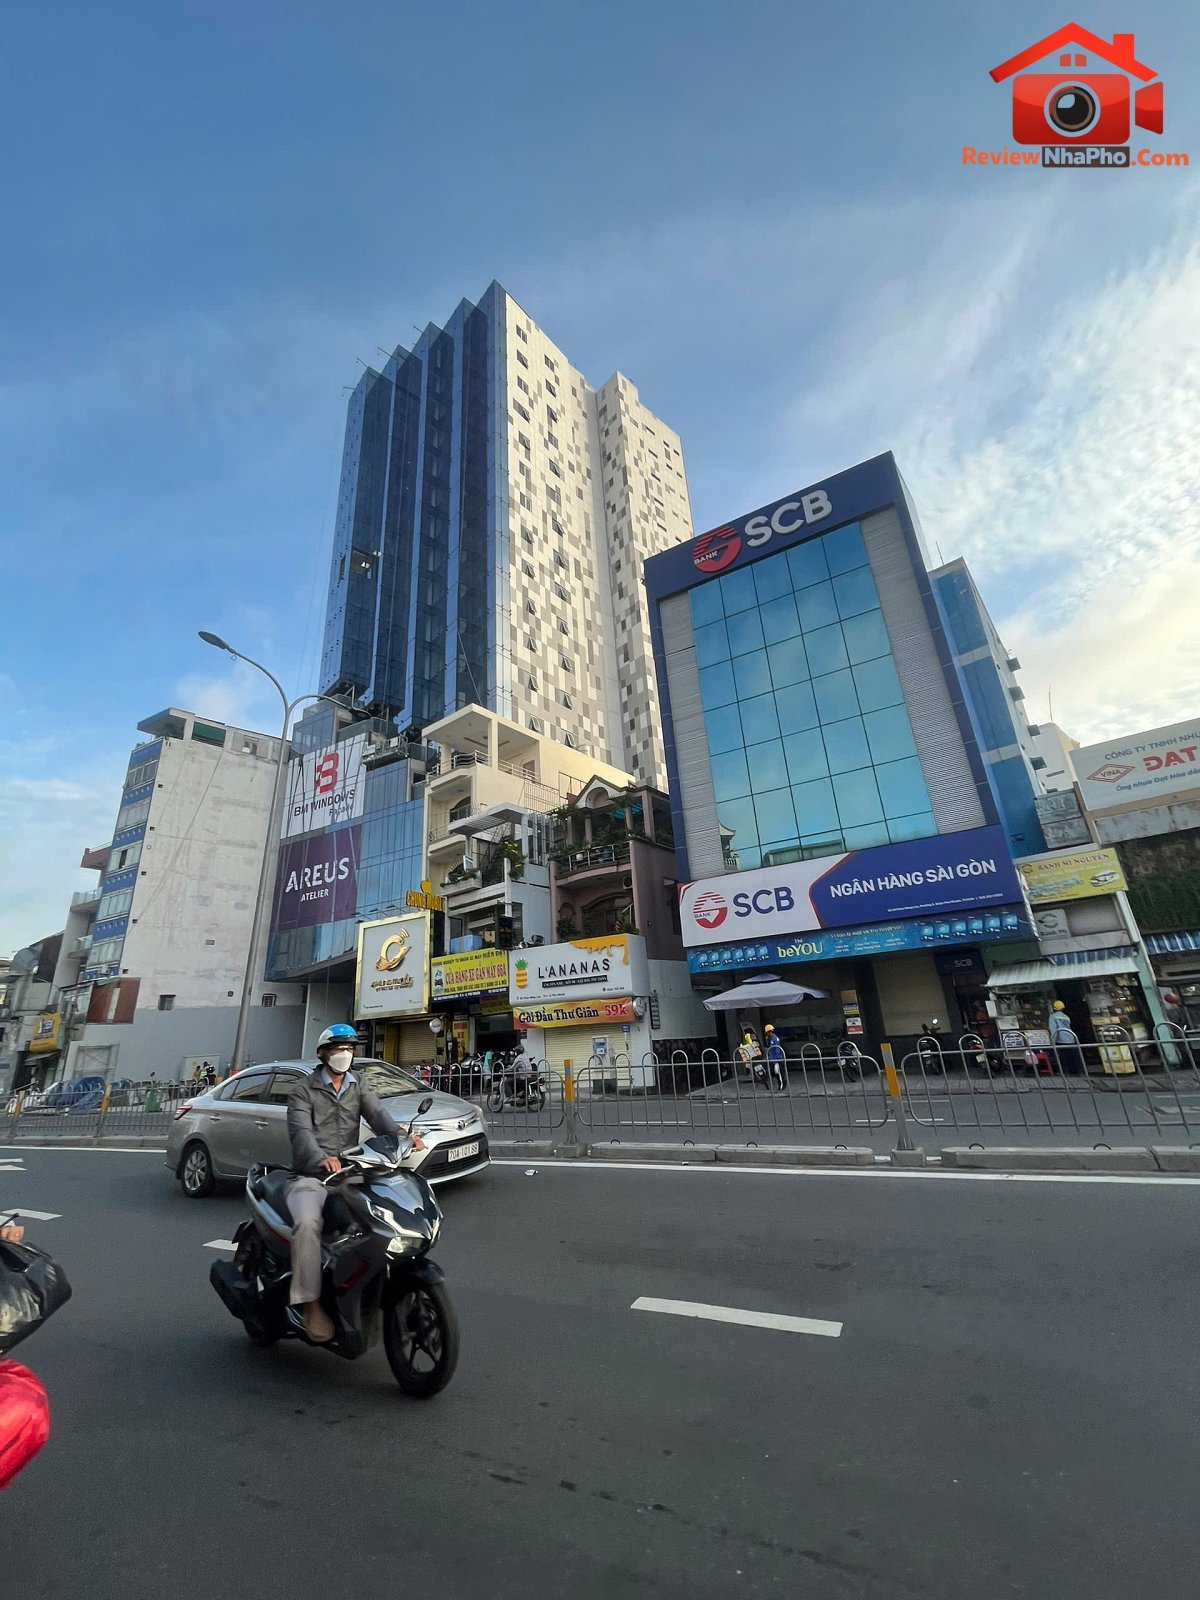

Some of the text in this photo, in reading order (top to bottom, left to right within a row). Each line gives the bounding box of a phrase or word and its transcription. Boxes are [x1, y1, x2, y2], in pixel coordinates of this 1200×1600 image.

[744, 489, 832, 548] SCB
[694, 551, 718, 565] BANK
[1134, 744, 1146, 754] TY
[1148, 738, 1177, 751] TNHH
[1100, 768, 1121, 778] VINA
[294, 789, 356, 817] BM WINDOWS
[285, 857, 350, 893] AREUS
[830, 858, 997, 898] NGÂN HÀNG SÀI GÒN
[300, 888, 329, 903] ATELIER
[732, 886, 795, 918] SCB
[777, 942, 823, 959] beYOU
[538, 958, 610, 979] L'ANANAS
[954, 958, 973, 968] SCB
[553, 1009, 575, 1021] Thư
[575, 1006, 600, 1019] Giãn
[604, 1003, 628, 1018] 59k
